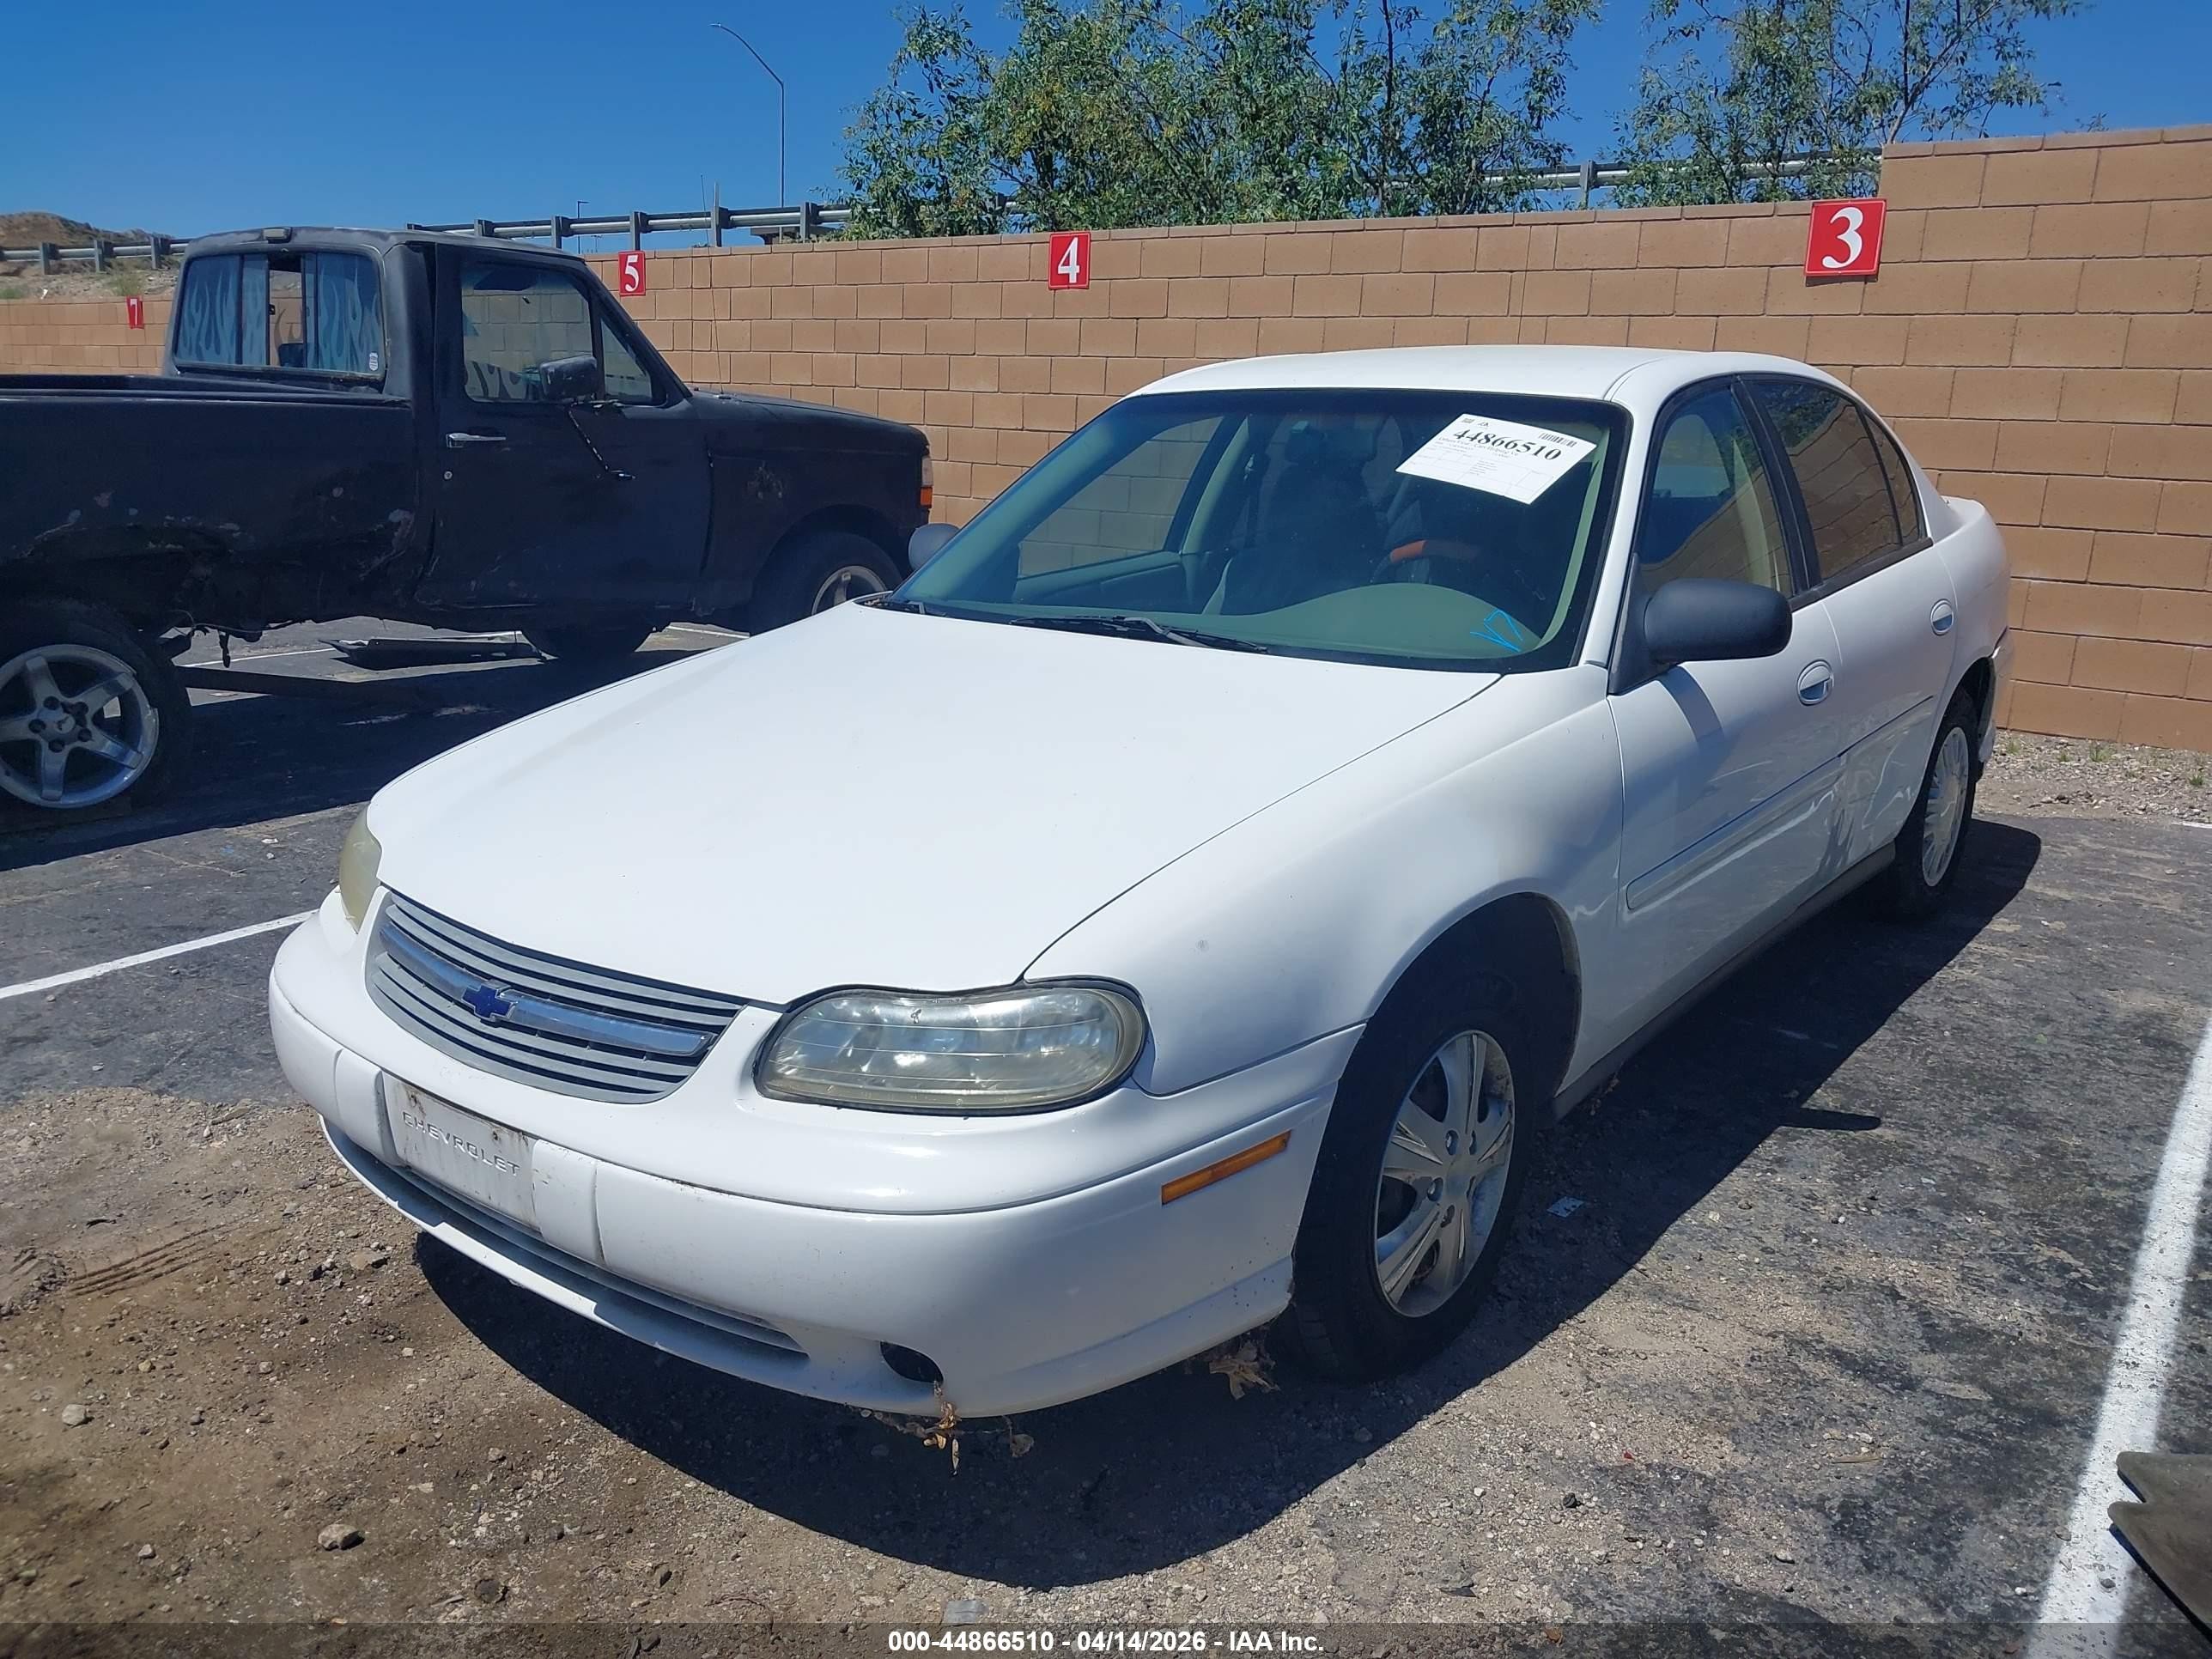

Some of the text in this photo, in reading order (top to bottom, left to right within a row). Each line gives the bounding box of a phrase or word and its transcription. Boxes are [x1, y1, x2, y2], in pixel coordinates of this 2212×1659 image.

[1057, 236, 1080, 283] 4
[1822, 207, 1863, 269] 3
[624, 254, 640, 292] 5
[1453, 428, 1562, 461] 44866510
[402, 1111, 520, 1176] CHEVROLET
